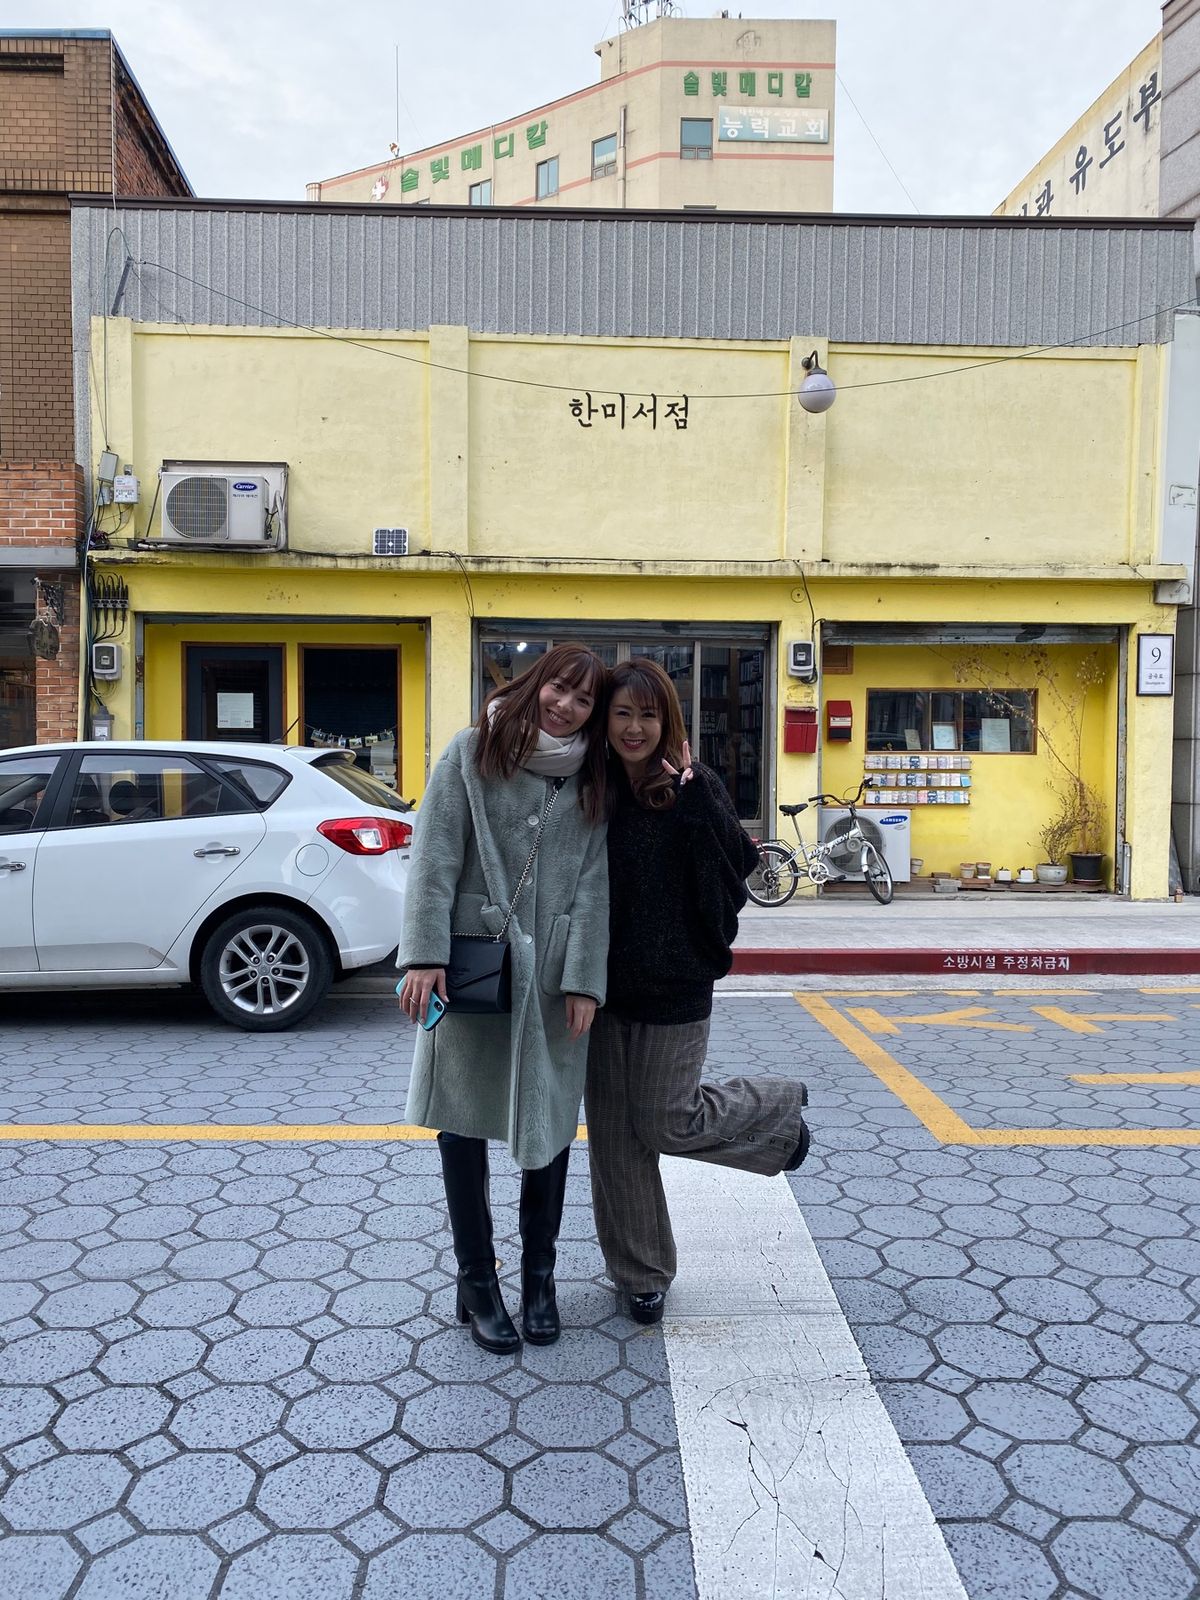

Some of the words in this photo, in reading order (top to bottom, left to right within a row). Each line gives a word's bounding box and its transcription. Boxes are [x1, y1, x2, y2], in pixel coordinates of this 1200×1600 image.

[722, 117, 824, 140] 능력교회
[568, 391, 689, 430] 한미서점
[1151, 646, 1162, 665] 9
[942, 955, 996, 970] 소방시설
[1002, 956, 1070, 971] 주정차금지
